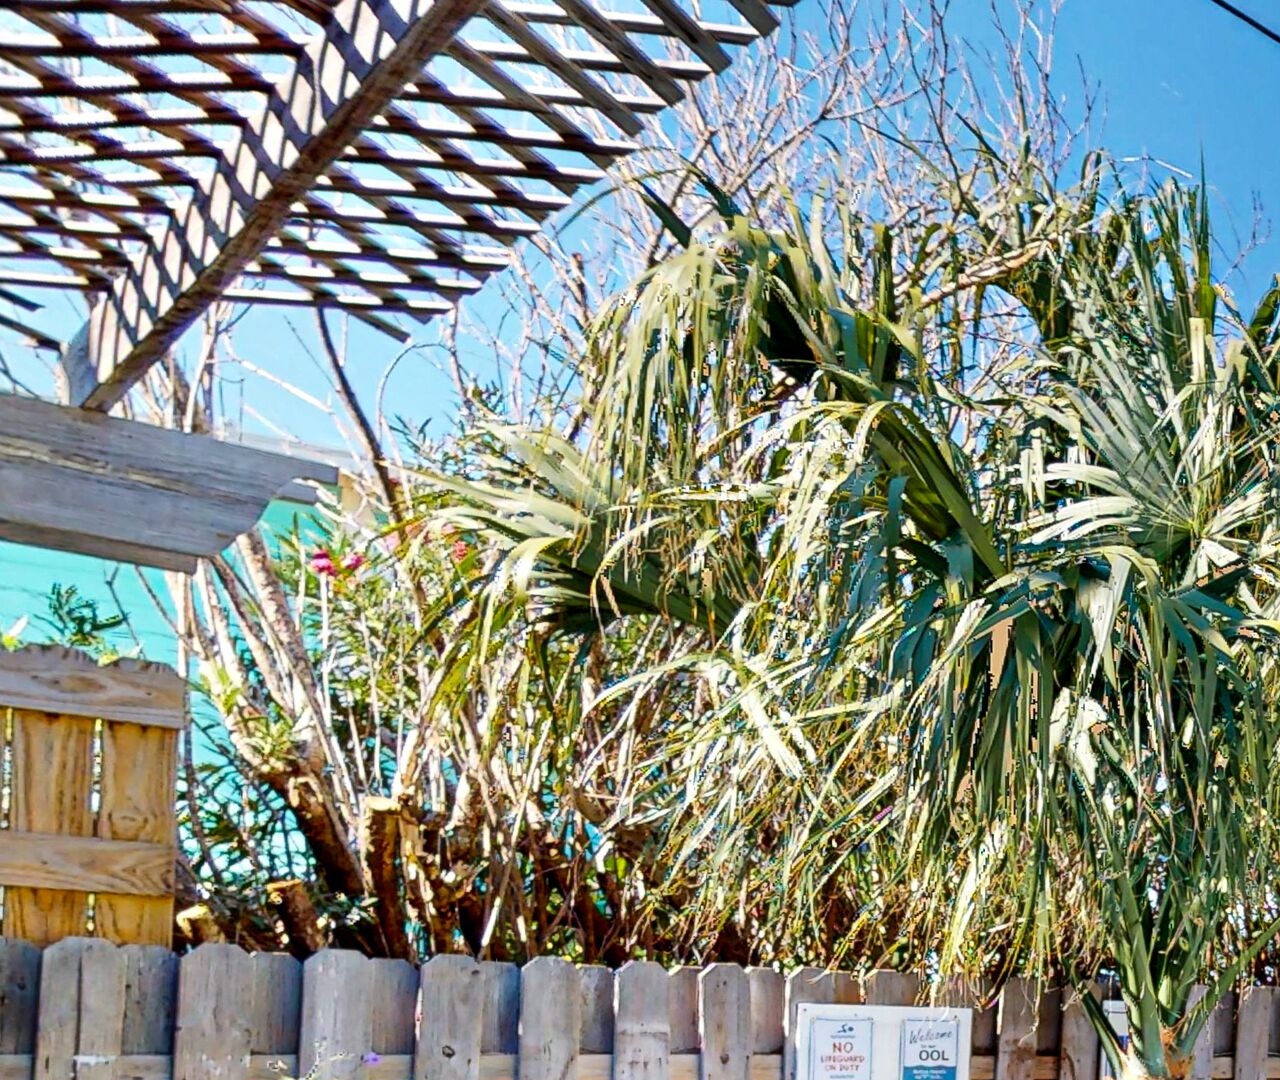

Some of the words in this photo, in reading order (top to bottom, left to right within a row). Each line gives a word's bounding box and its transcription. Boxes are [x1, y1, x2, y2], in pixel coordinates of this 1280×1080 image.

[909, 1028, 952, 1044] Welcome
[833, 1042, 853, 1053] NO
[919, 1050, 949, 1061] OOL
